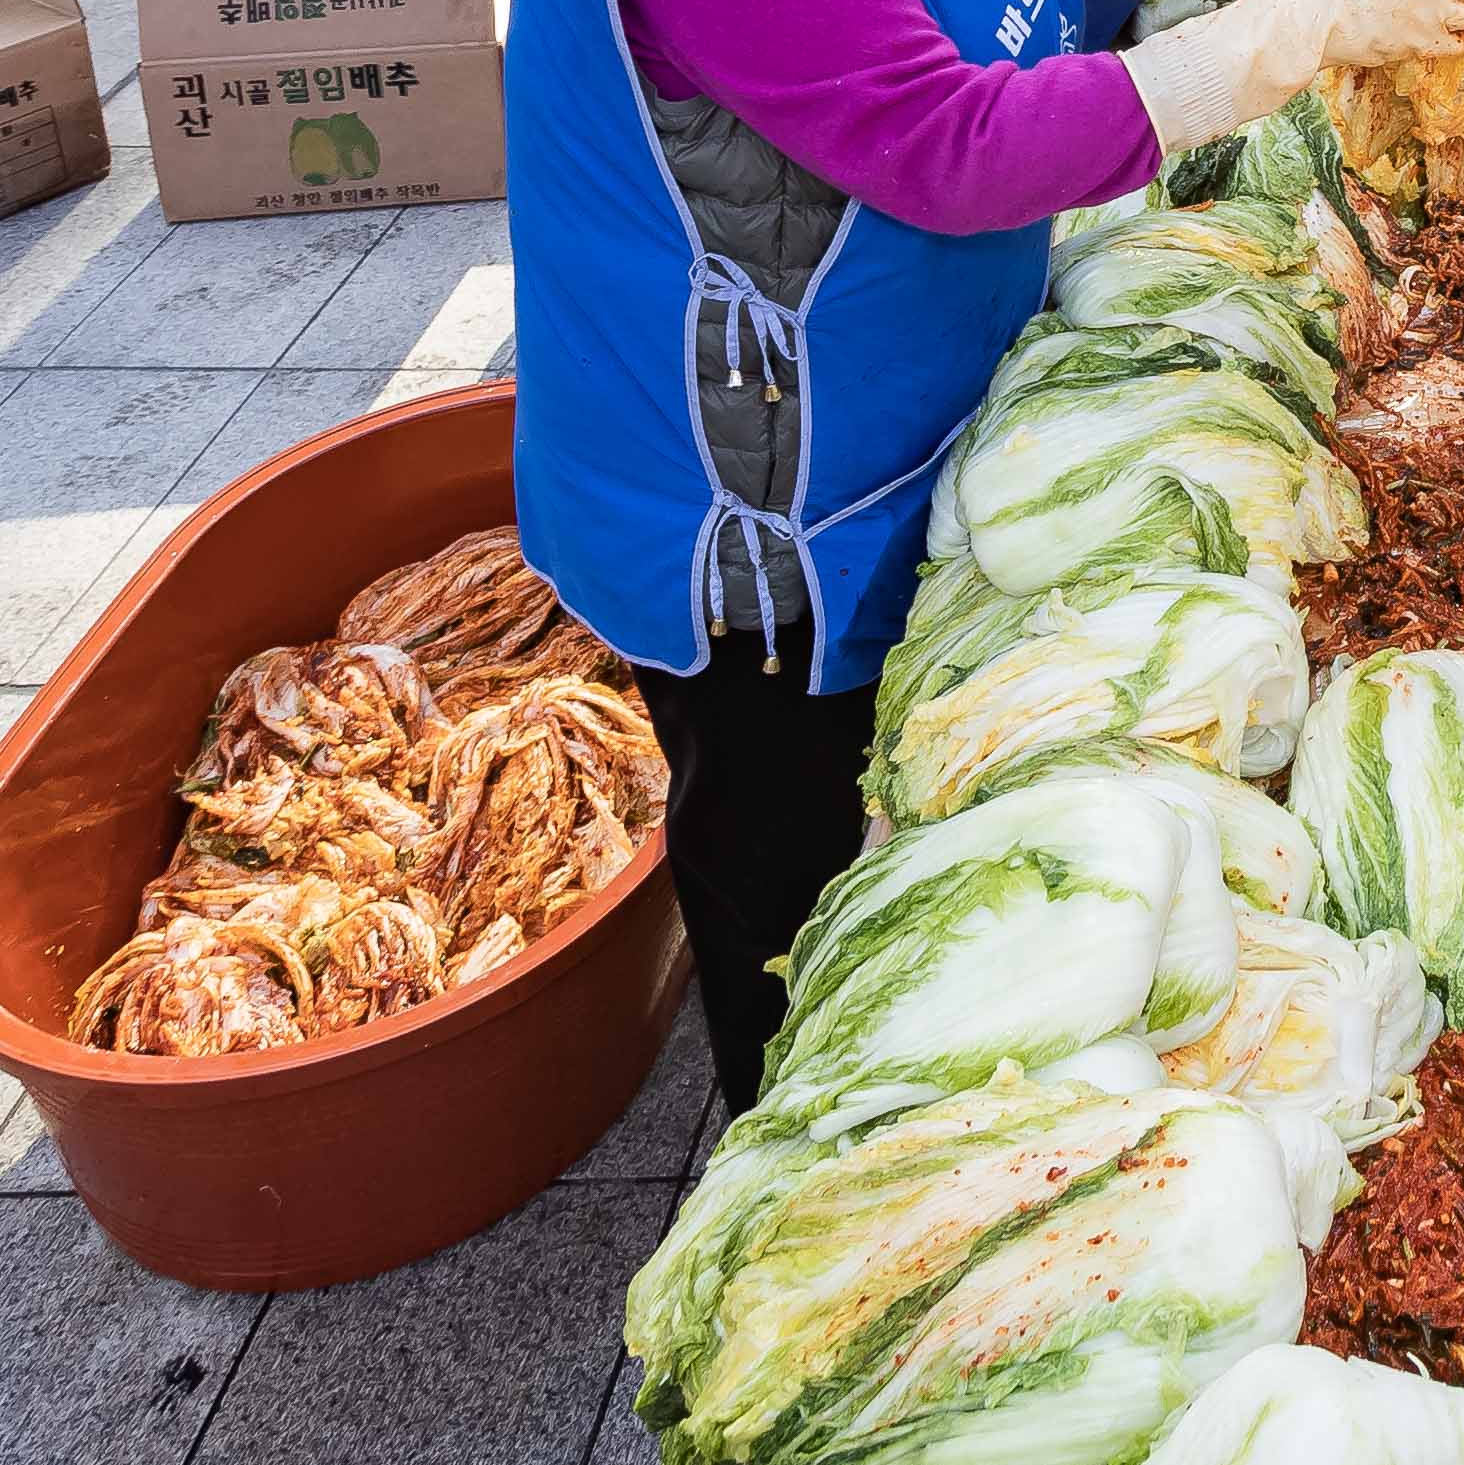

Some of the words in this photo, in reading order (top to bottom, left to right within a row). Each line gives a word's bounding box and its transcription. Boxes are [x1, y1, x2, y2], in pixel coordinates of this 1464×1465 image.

[172, 73, 214, 138] 괴산
[255, 196, 285, 210] 괴산
[329, 187, 389, 205] 절임배추
